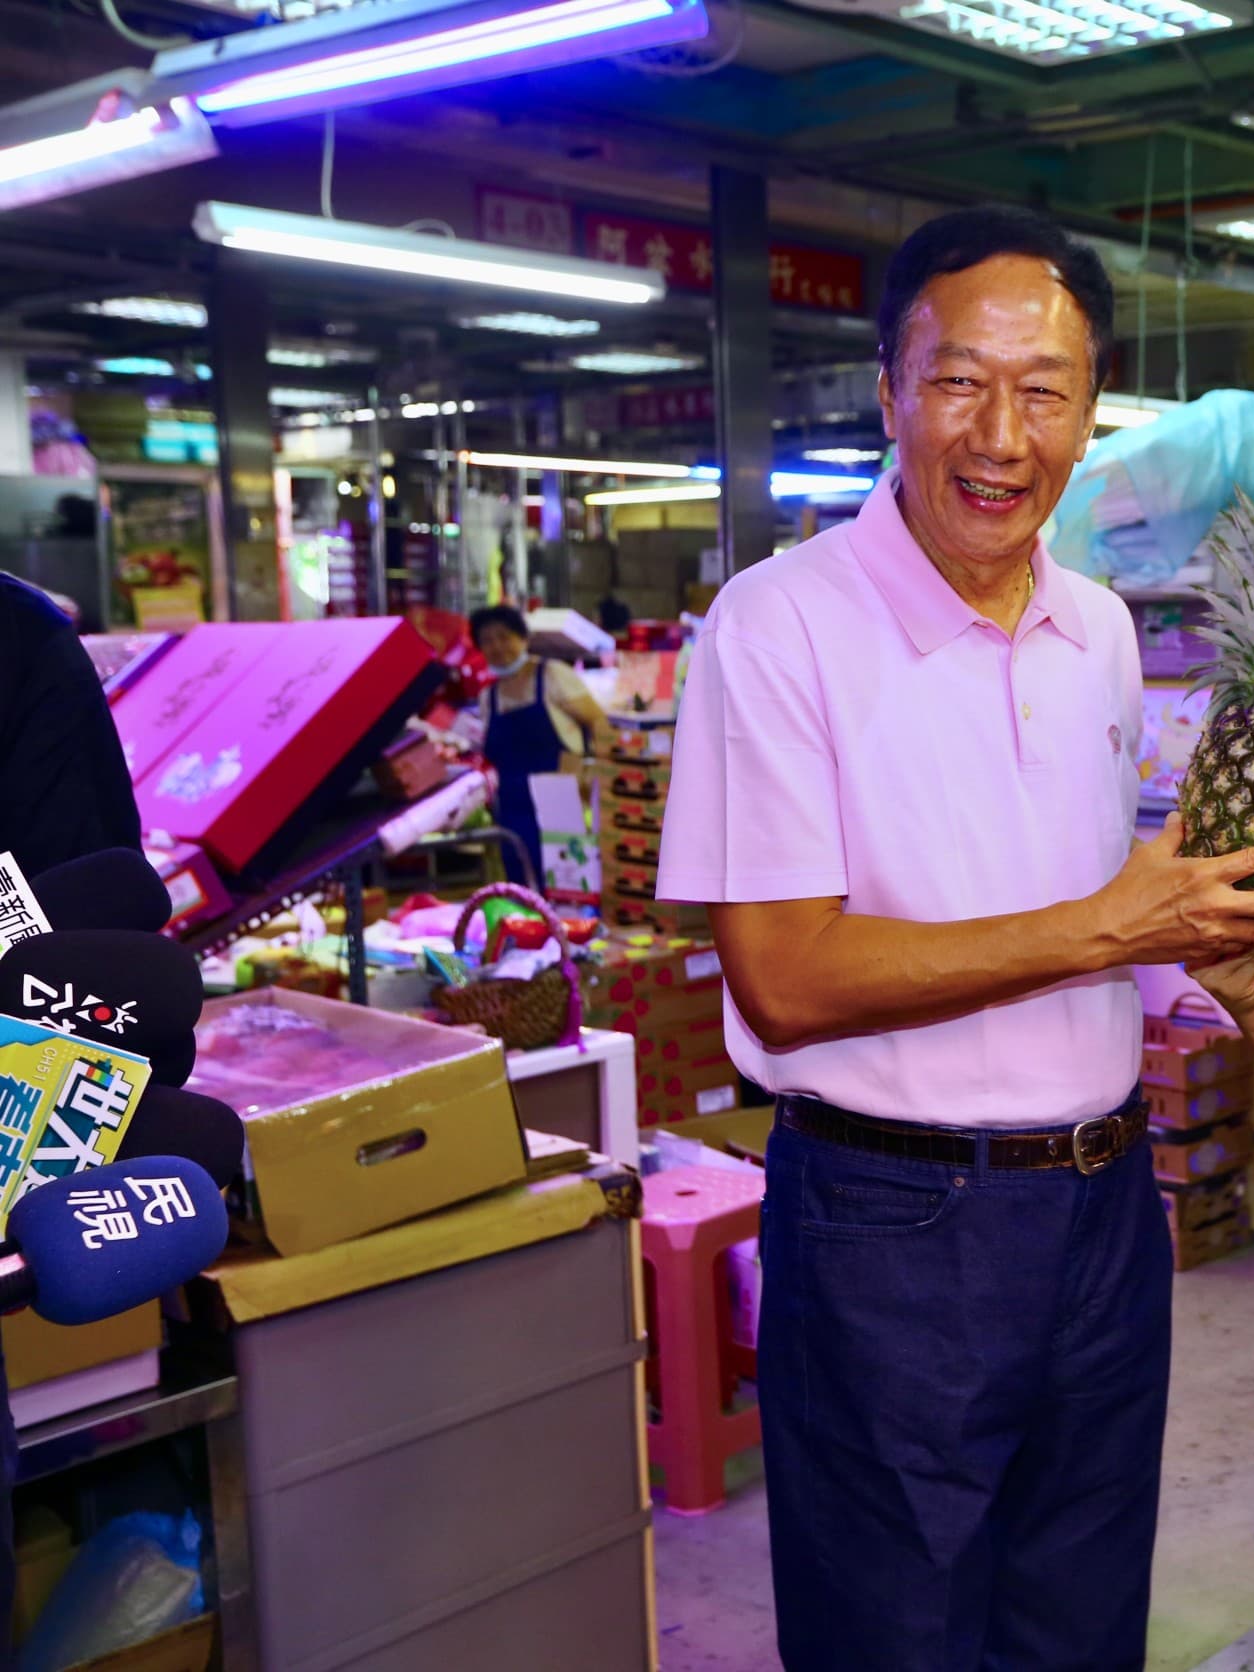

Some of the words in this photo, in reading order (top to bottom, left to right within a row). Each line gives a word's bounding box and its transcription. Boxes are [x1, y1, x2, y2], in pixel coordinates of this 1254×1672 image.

[33, 1047, 58, 1082] CH51
[8, 1058, 135, 1208] 世大
[66, 1176, 196, 1250] 民視
